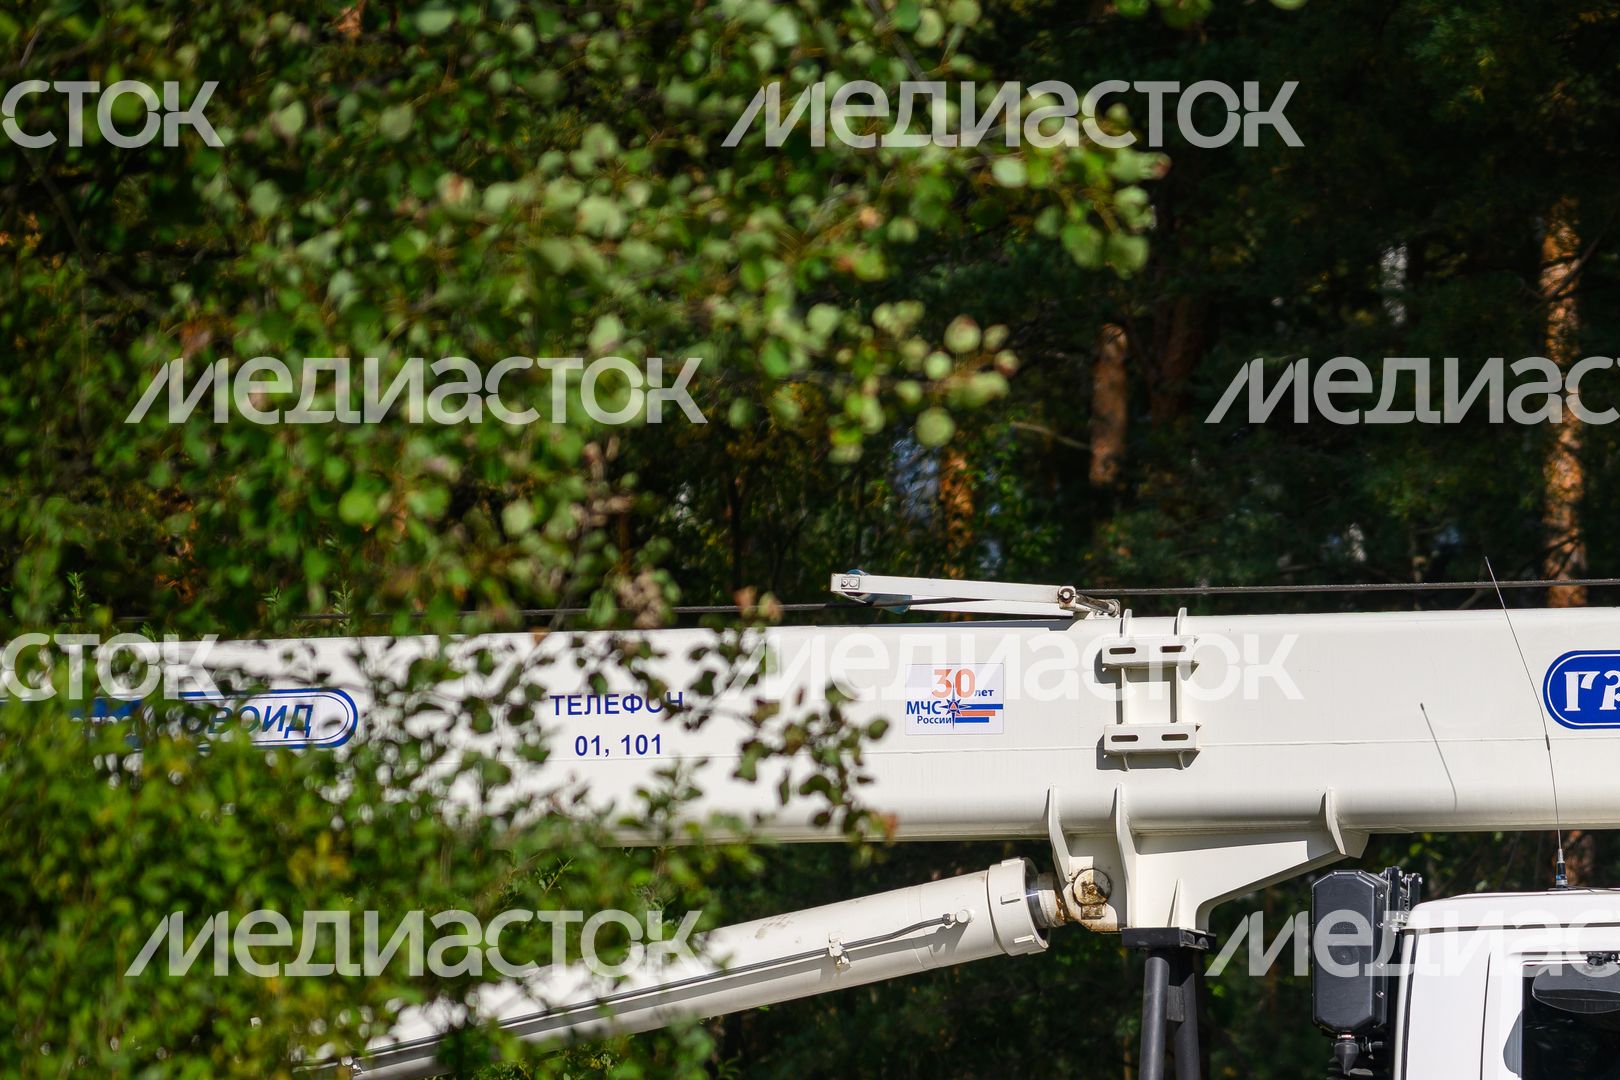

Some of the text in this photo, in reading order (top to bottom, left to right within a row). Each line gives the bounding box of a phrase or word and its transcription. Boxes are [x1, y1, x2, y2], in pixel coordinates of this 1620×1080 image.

[931, 668, 994, 698] 30 лет
[906, 700, 941, 715] МЧС
[917, 715, 952, 724] России
[575, 733, 661, 757] 01, 101
